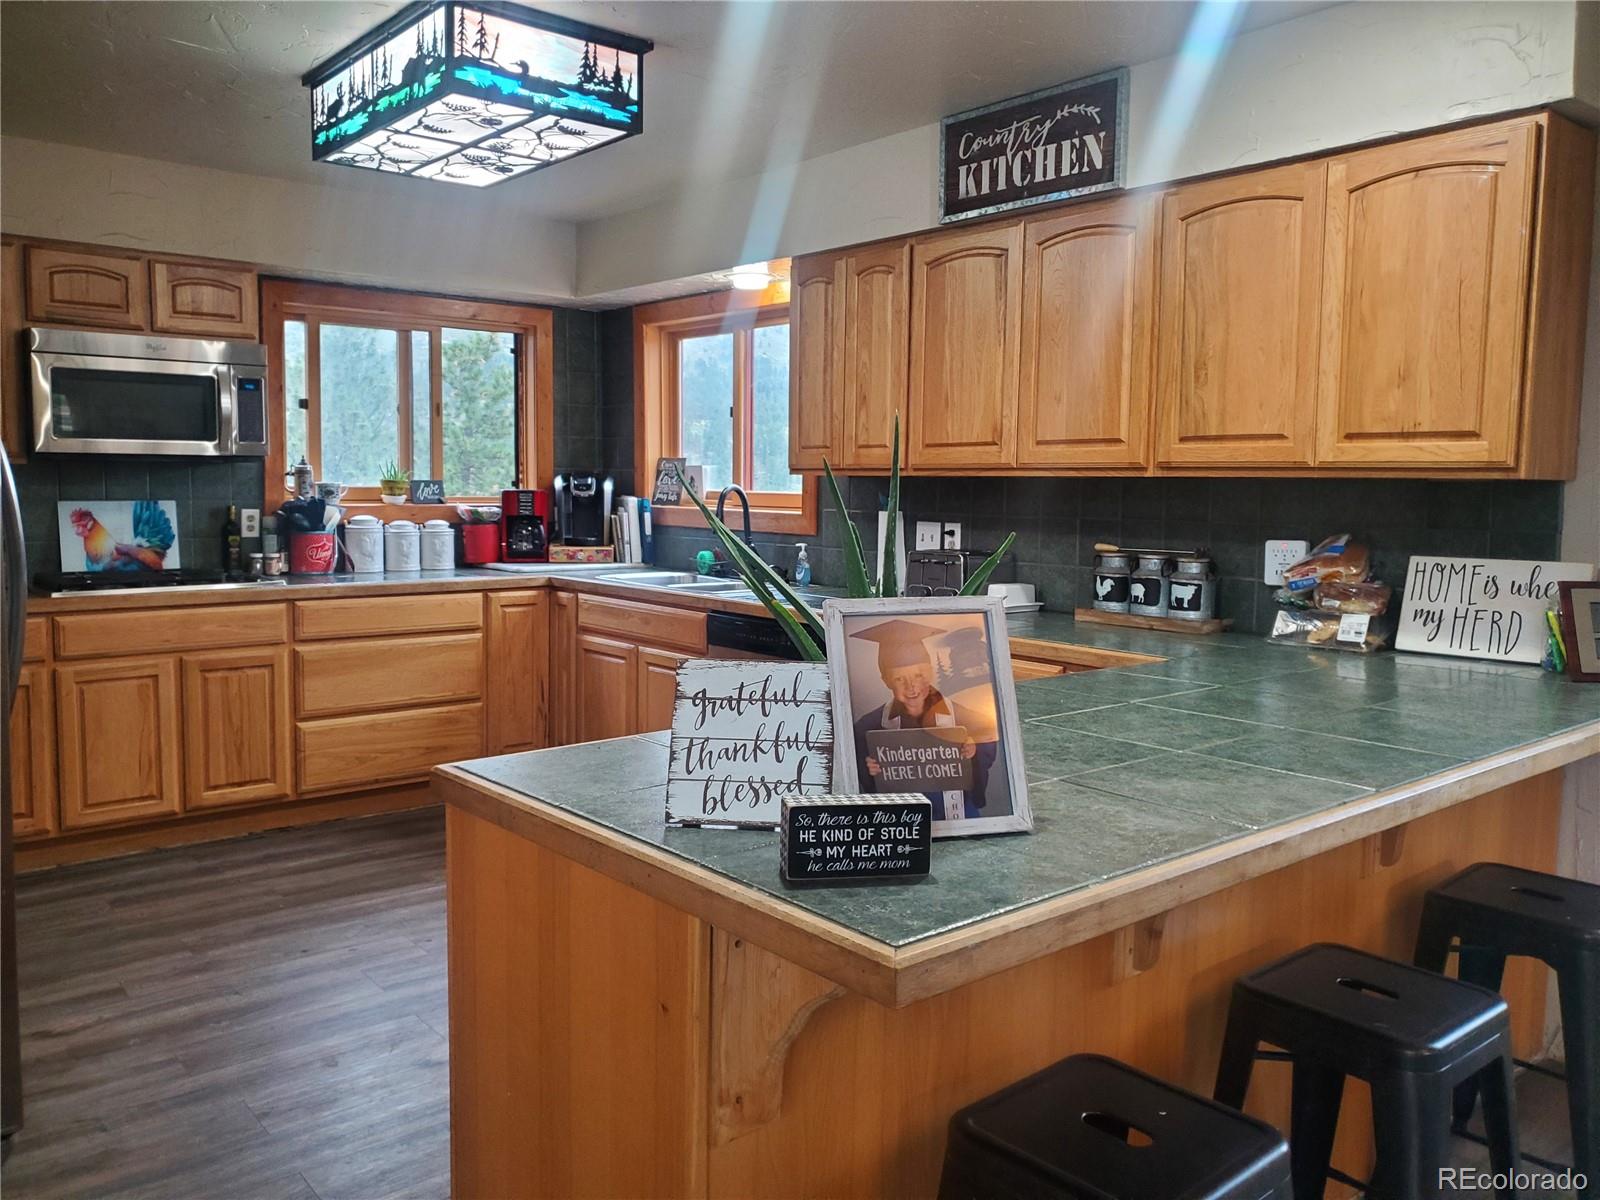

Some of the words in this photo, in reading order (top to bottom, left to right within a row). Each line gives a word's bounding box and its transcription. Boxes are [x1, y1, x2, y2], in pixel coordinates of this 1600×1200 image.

[959, 114, 1056, 165] Country
[957, 131, 1106, 200] KITCHEN
[1410, 562, 1485, 606] HOME
[1483, 575, 1499, 600] is
[1510, 565, 1560, 599] whe
[1413, 608, 1445, 642] my
[1450, 607, 1523, 655] HERD
[691, 671, 811, 731] grateful
[681, 714, 822, 776] thankful
[702, 756, 810, 815] blessed
[882, 765, 917, 780] HERE
[917, 765, 923, 779] I
[795, 813, 815, 828] So,
[817, 812, 853, 826] there
[856, 813, 869, 825] is
[872, 810, 897, 824] this
[900, 809, 924, 826] boy
[799, 829, 817, 843] HE
[822, 829, 853, 842] KIND
[858, 828, 875, 841] OF
[880, 826, 920, 840] STOLE
[807, 859, 823, 872] he
[826, 858, 854, 872] calls
[857, 860, 878, 870] me
[879, 859, 911, 870] mom
[826, 845, 847, 859] MY
[851, 843, 893, 858] HEART
